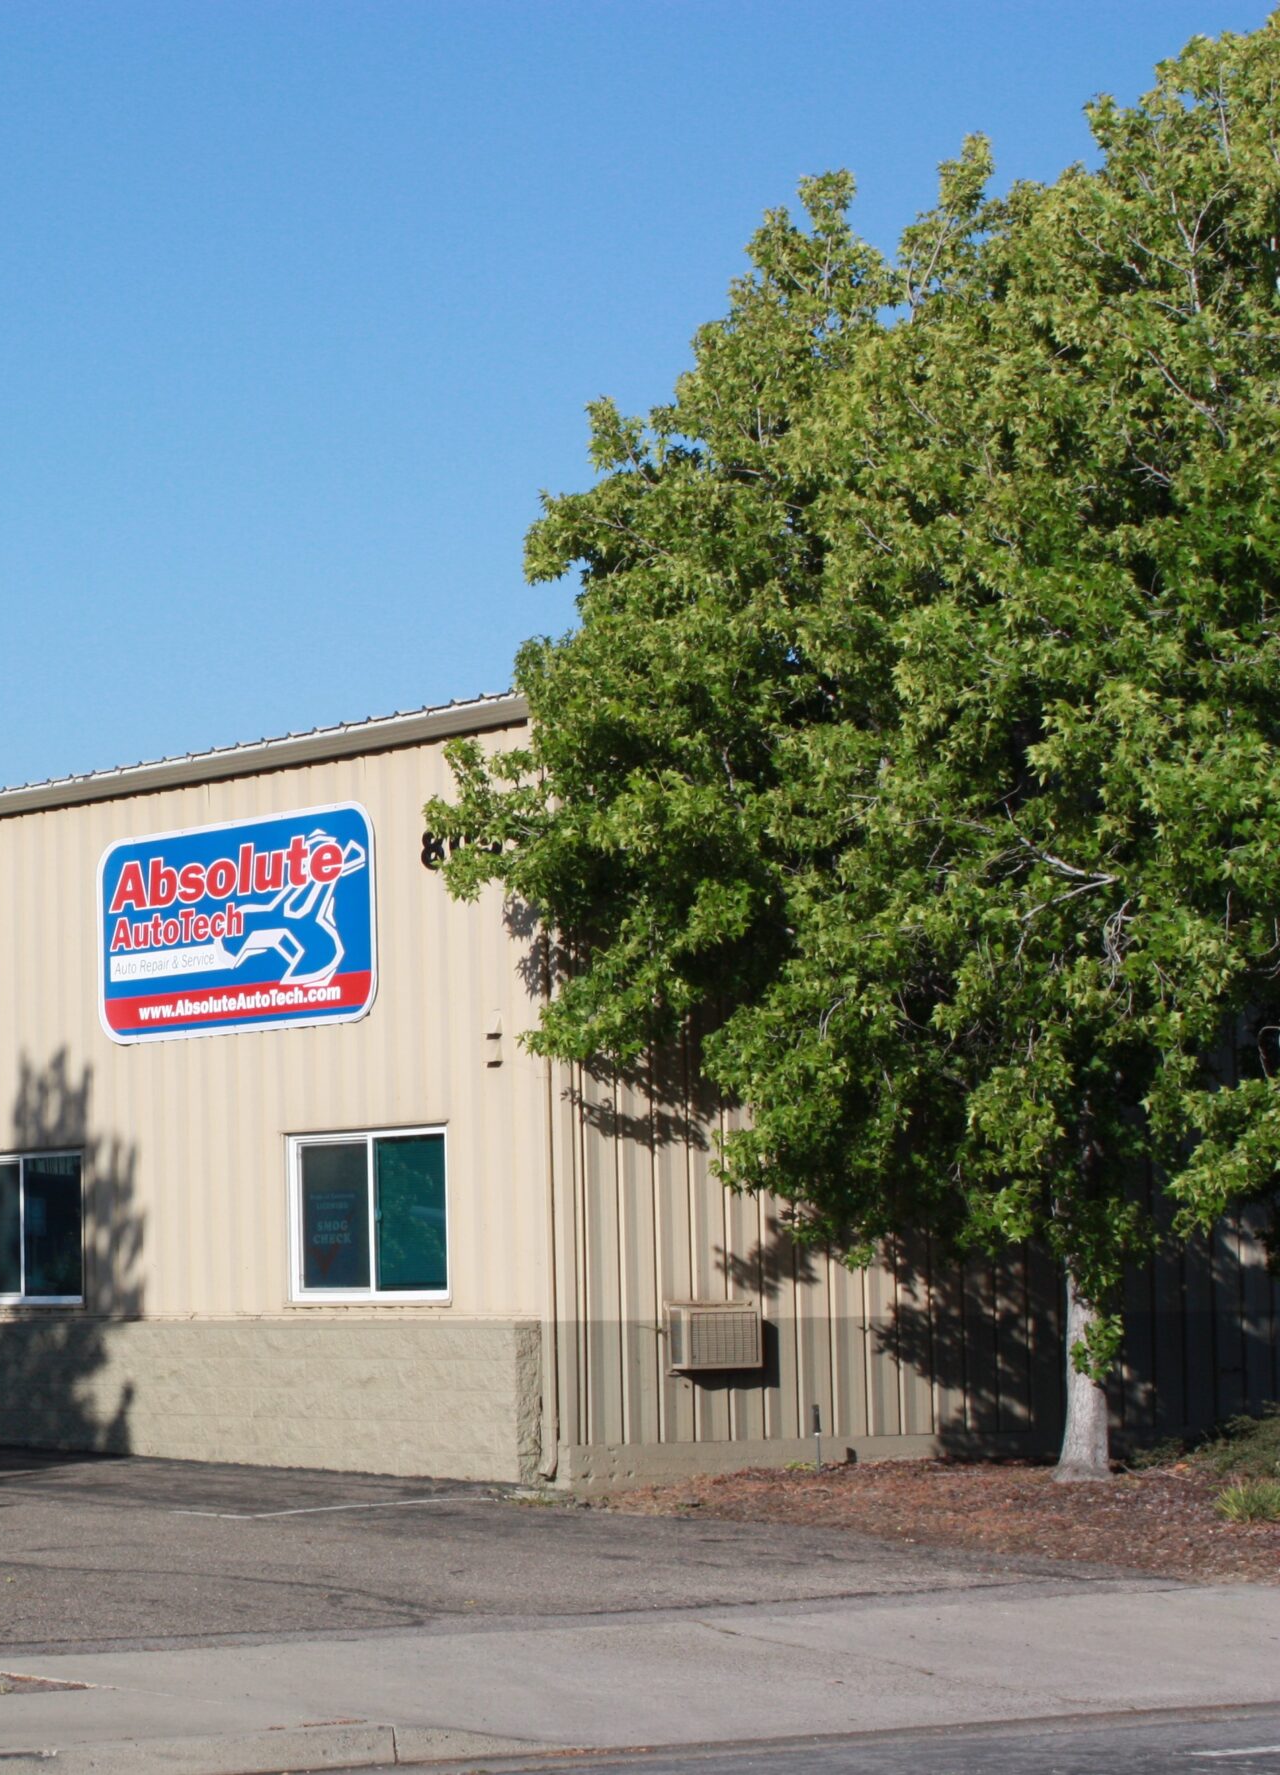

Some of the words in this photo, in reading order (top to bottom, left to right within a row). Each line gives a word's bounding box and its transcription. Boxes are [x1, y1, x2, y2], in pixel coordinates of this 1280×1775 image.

[110, 836, 344, 913] Absolute
[110, 903, 243, 952] AutoTech
[114, 962, 137, 976] Auto
[139, 957, 170, 974] Repair
[171, 955, 179, 969] &
[181, 953, 215, 968] Service
[139, 986, 340, 1020] www.AbsoluteAutoTech.com
[313, 1233, 352, 1245] CHECK
[317, 1220, 348, 1232] SMOG
